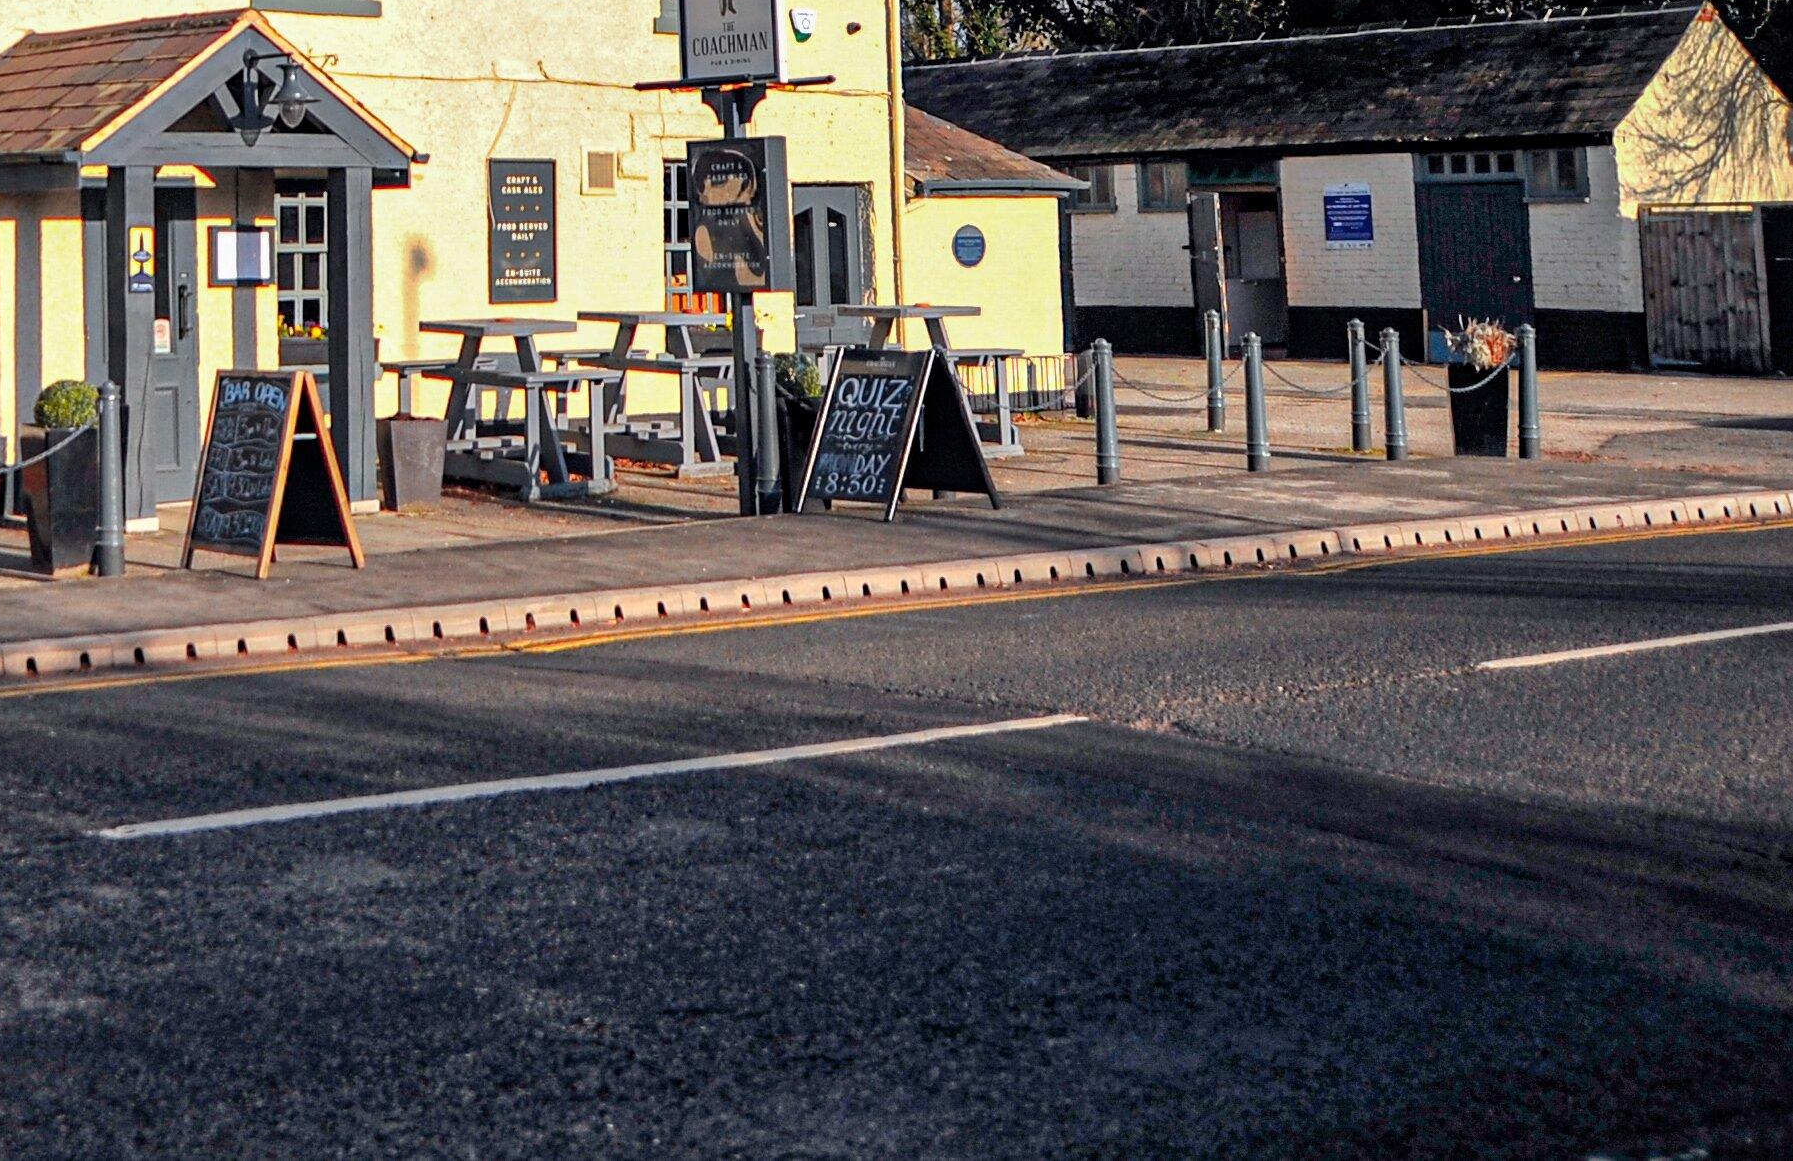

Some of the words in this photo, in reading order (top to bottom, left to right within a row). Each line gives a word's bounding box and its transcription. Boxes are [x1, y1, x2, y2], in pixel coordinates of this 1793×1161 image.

[722, 21, 736, 32] THE
[692, 31, 769, 57] COACHMAN
[710, 162, 735, 171] CRAFT
[506, 176, 531, 185] CRAFT
[706, 172, 727, 182] CASK
[501, 186, 522, 195] CASK
[523, 186, 543, 195] ALES
[702, 208, 722, 216] FOOD
[497, 222, 517, 231] FOOD
[519, 222, 549, 231] SERVED
[718, 218, 740, 226] DAILY
[511, 232, 535, 241] DAILY
[505, 268, 542, 278] EN-SUITE
[223, 381, 251, 404] BAR
[254, 382, 286, 412] OPEN
[837, 377, 909, 409] QUIZ
[828, 408, 901, 440] night
[824, 472, 877, 494] 8:30
